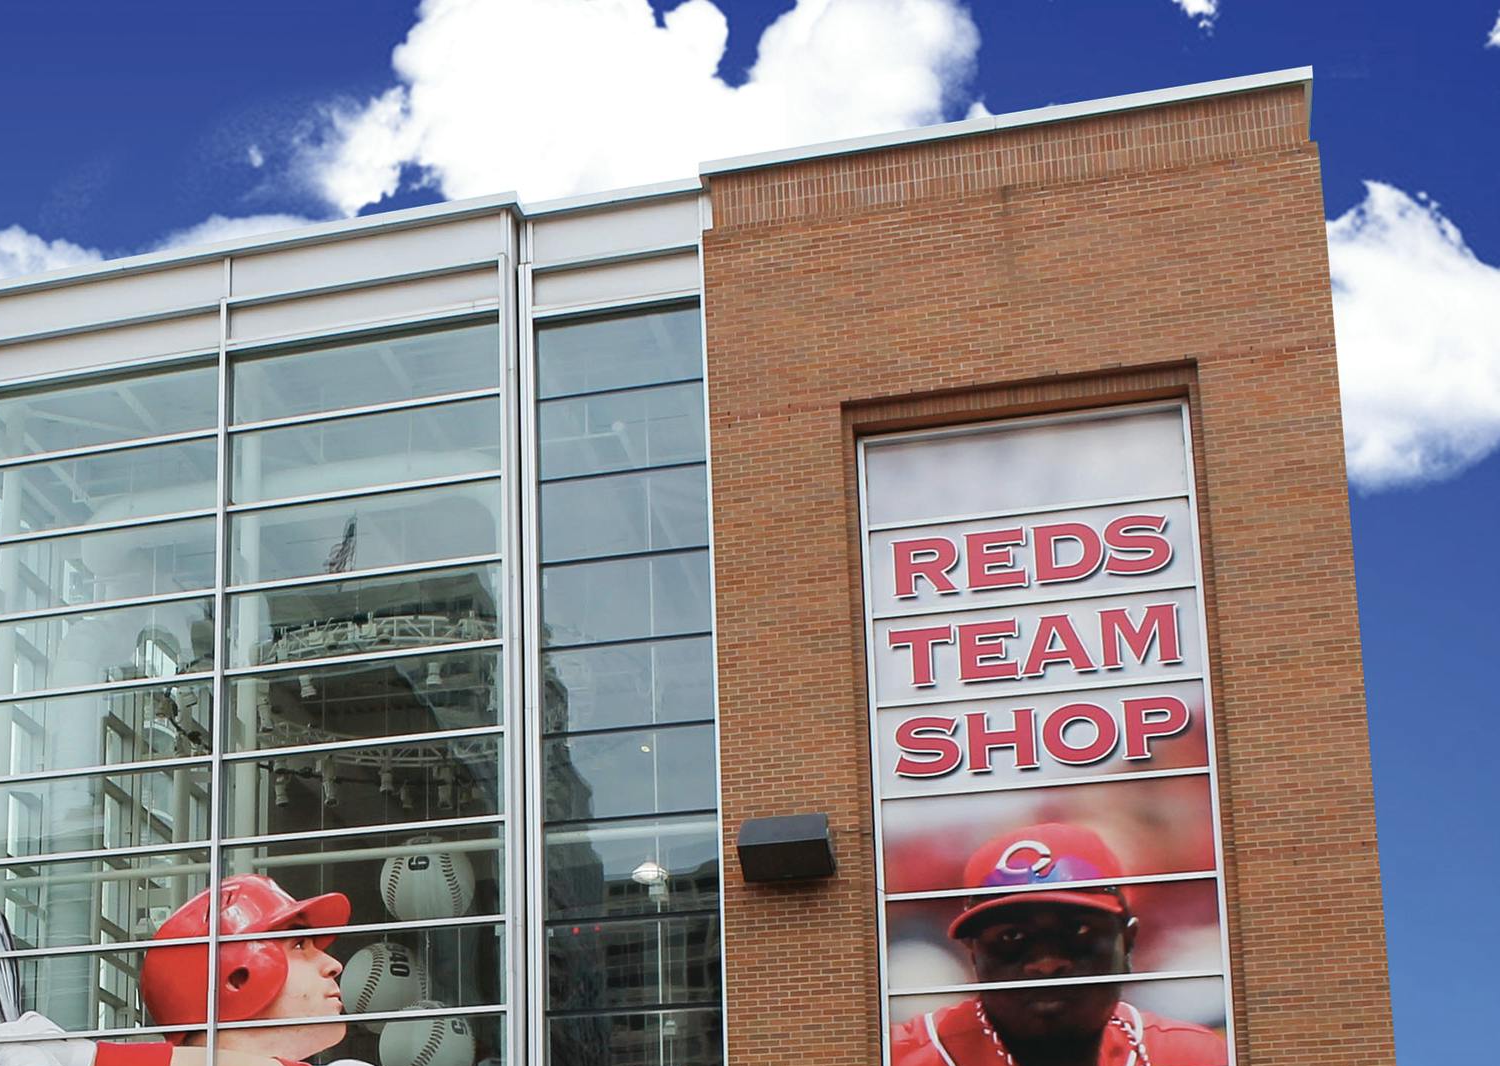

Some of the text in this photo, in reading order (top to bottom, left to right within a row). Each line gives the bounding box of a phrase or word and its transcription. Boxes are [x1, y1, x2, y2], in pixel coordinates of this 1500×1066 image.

[890, 514, 1174, 598] REDS
[888, 603, 1184, 688] TEAM
[894, 695, 1190, 777] SHOP
